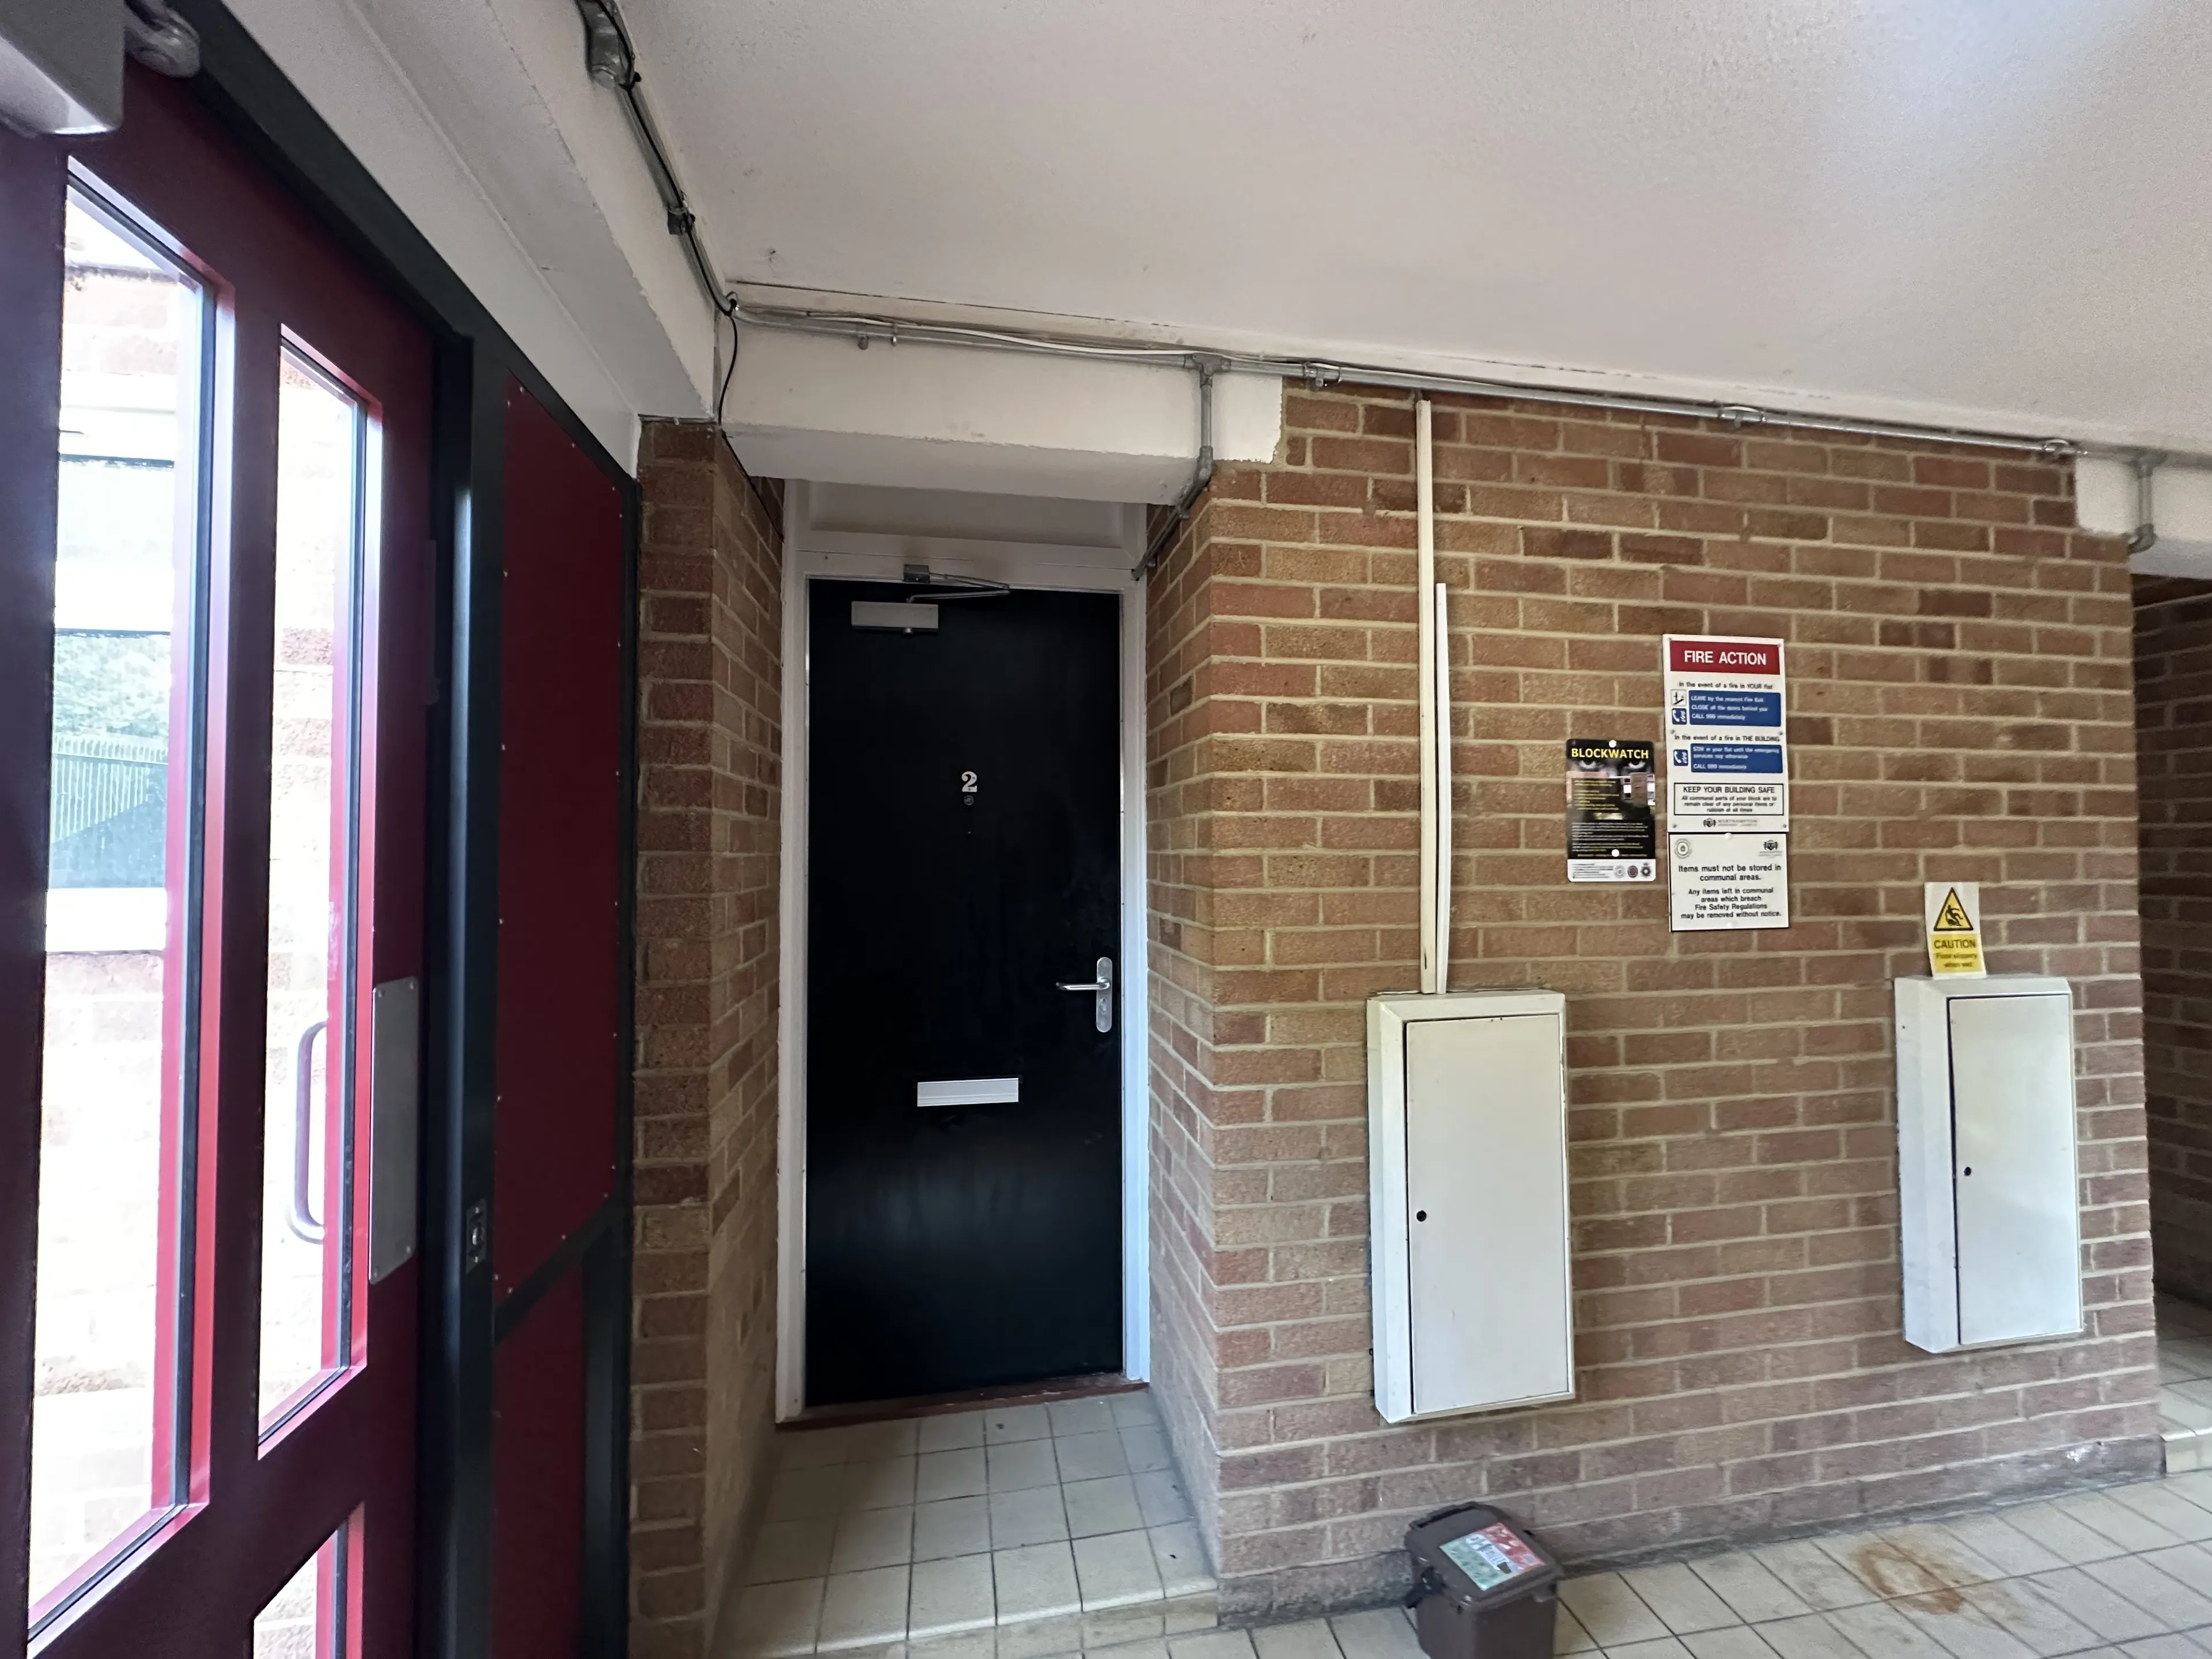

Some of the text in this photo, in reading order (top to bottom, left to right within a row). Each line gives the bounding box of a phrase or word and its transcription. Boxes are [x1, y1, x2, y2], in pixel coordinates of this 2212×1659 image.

[1684, 650, 1767, 665] FIRE ACTION
[1571, 748, 1649, 759] BLOCKWATCH
[961, 771, 978, 793] 2
[1934, 940, 1975, 949] CAUTION
